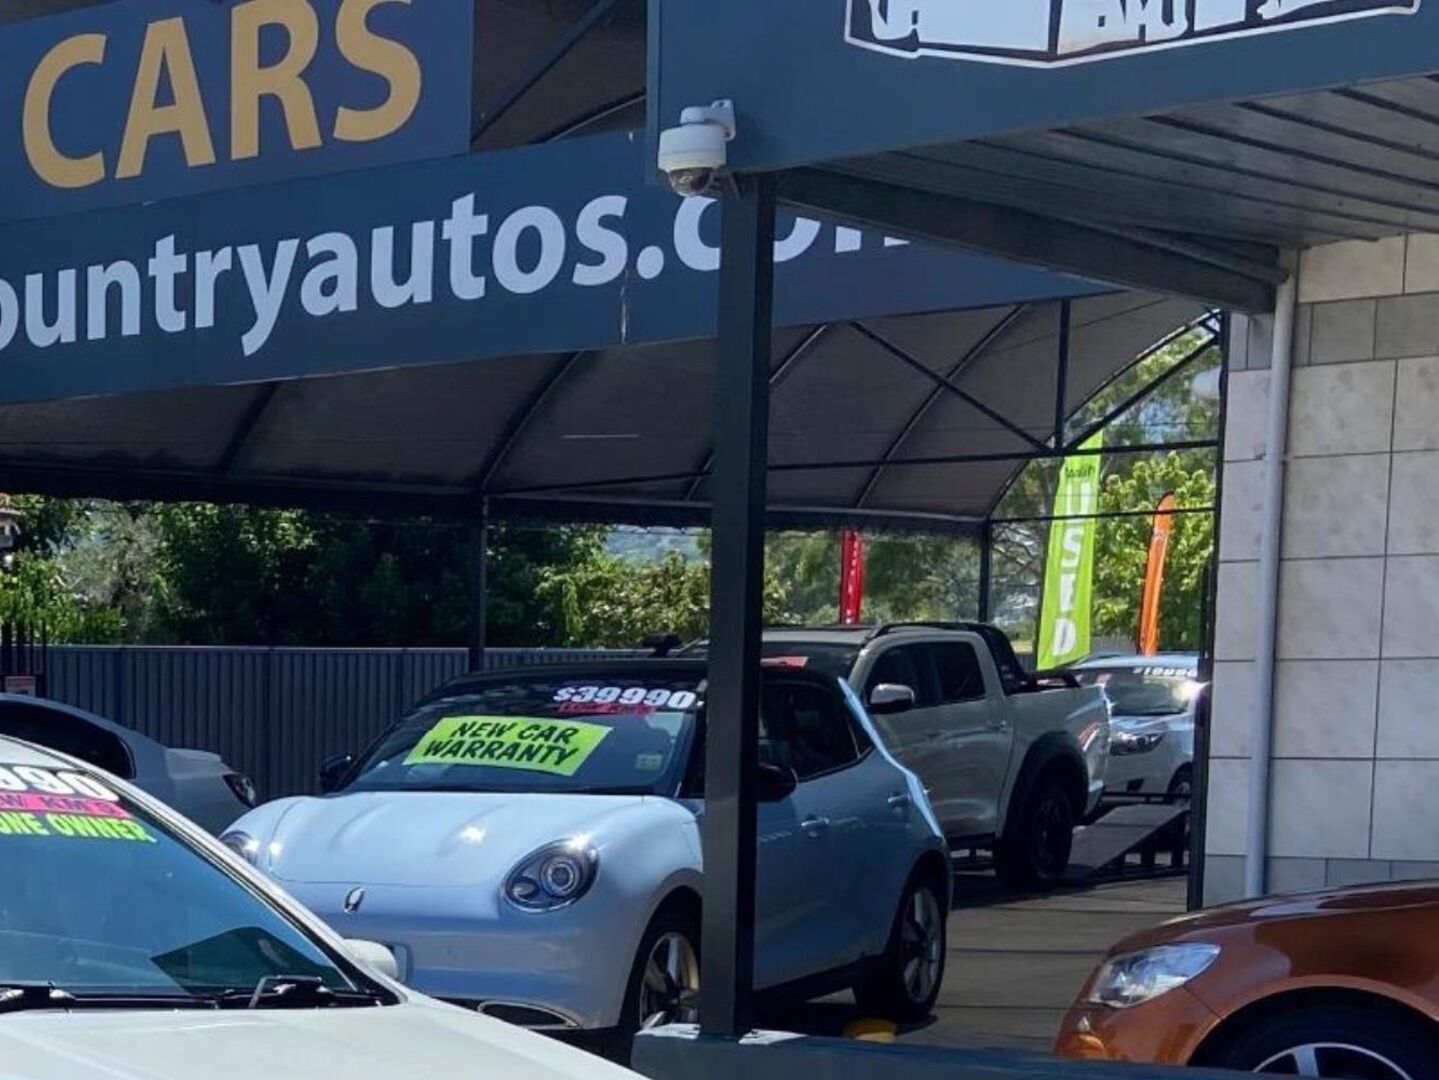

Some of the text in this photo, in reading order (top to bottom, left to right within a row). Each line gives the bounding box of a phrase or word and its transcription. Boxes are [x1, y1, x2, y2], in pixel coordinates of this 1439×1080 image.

[22, 0, 422, 189] CARS
[552, 685, 697, 709] $39990
[449, 720, 580, 745] NEW CAR
[422, 739, 582, 767] WARRANTY
[45, 812, 158, 843] OWNER
